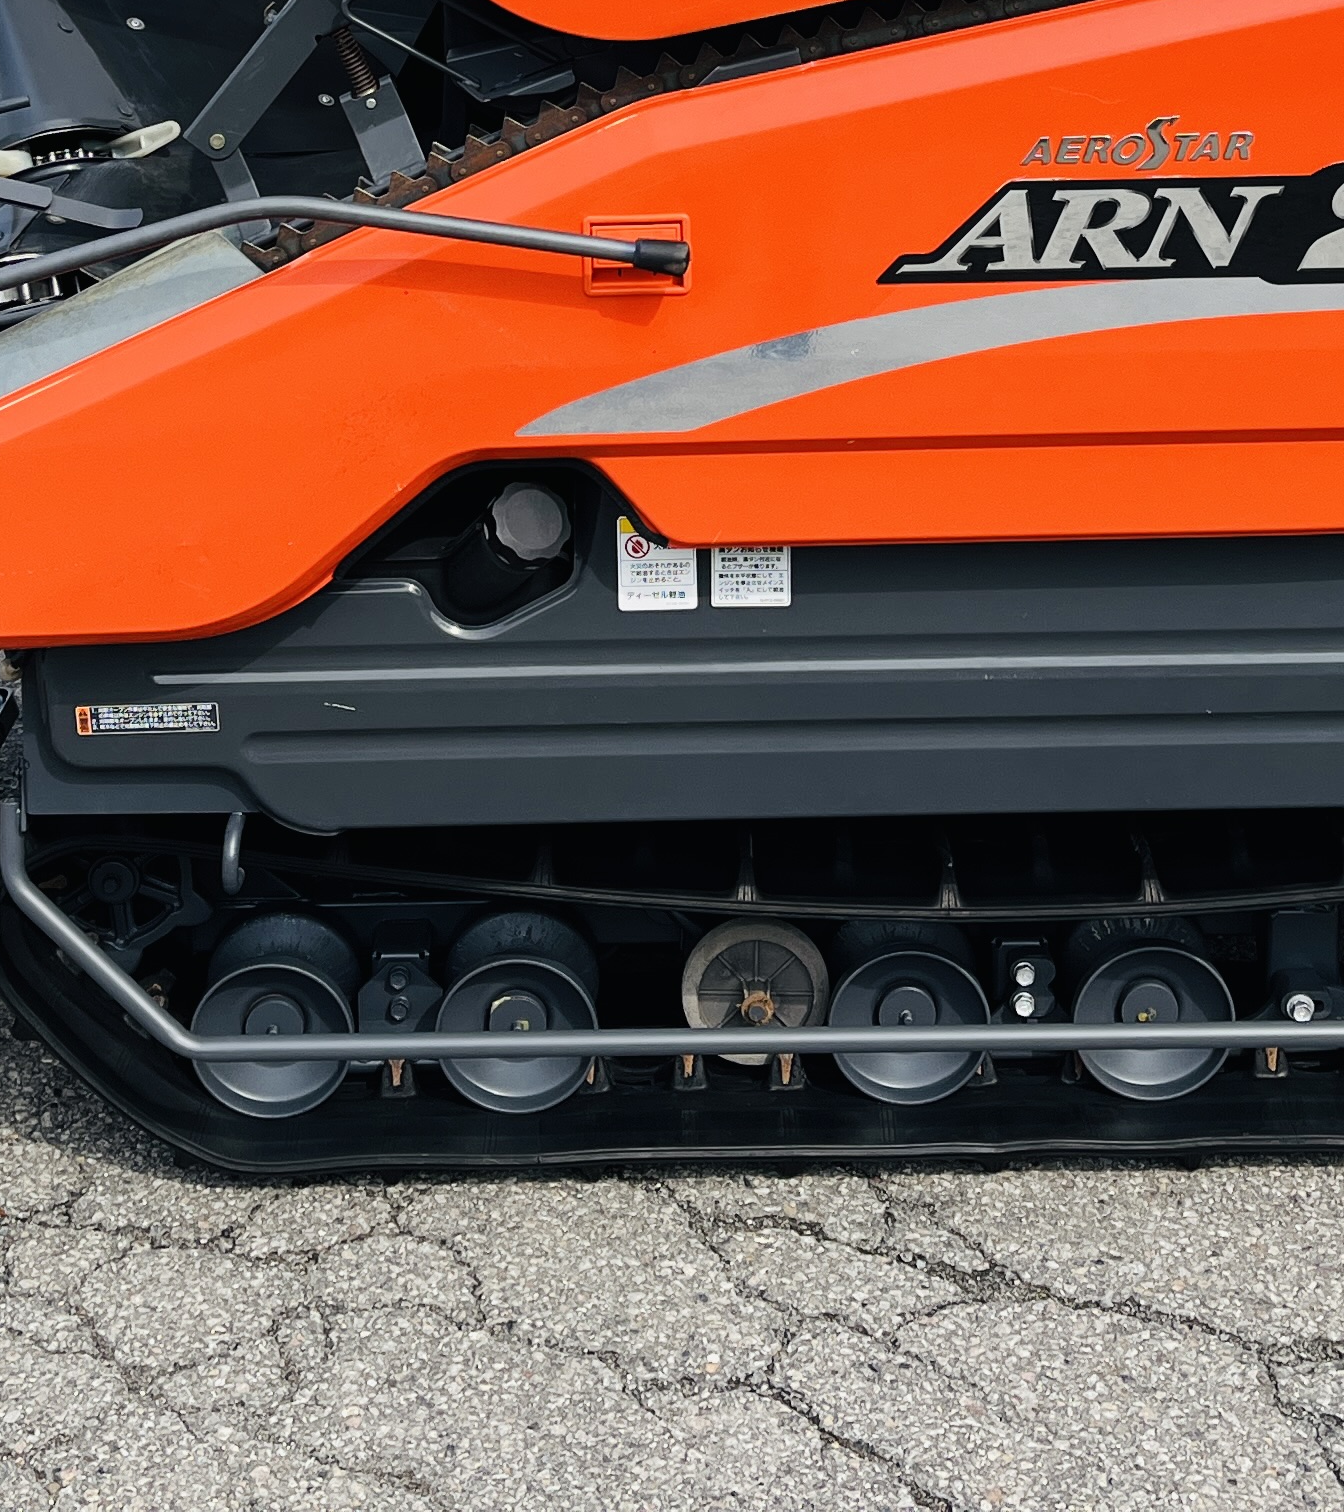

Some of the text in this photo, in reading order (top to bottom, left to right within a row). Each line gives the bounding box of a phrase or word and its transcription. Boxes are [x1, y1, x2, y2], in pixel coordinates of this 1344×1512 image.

[1020, 116, 1255, 170] AEROSTAR
[896, 184, 1287, 275] ARN
[627, 590, 686, 600] ディーゼル軽油
